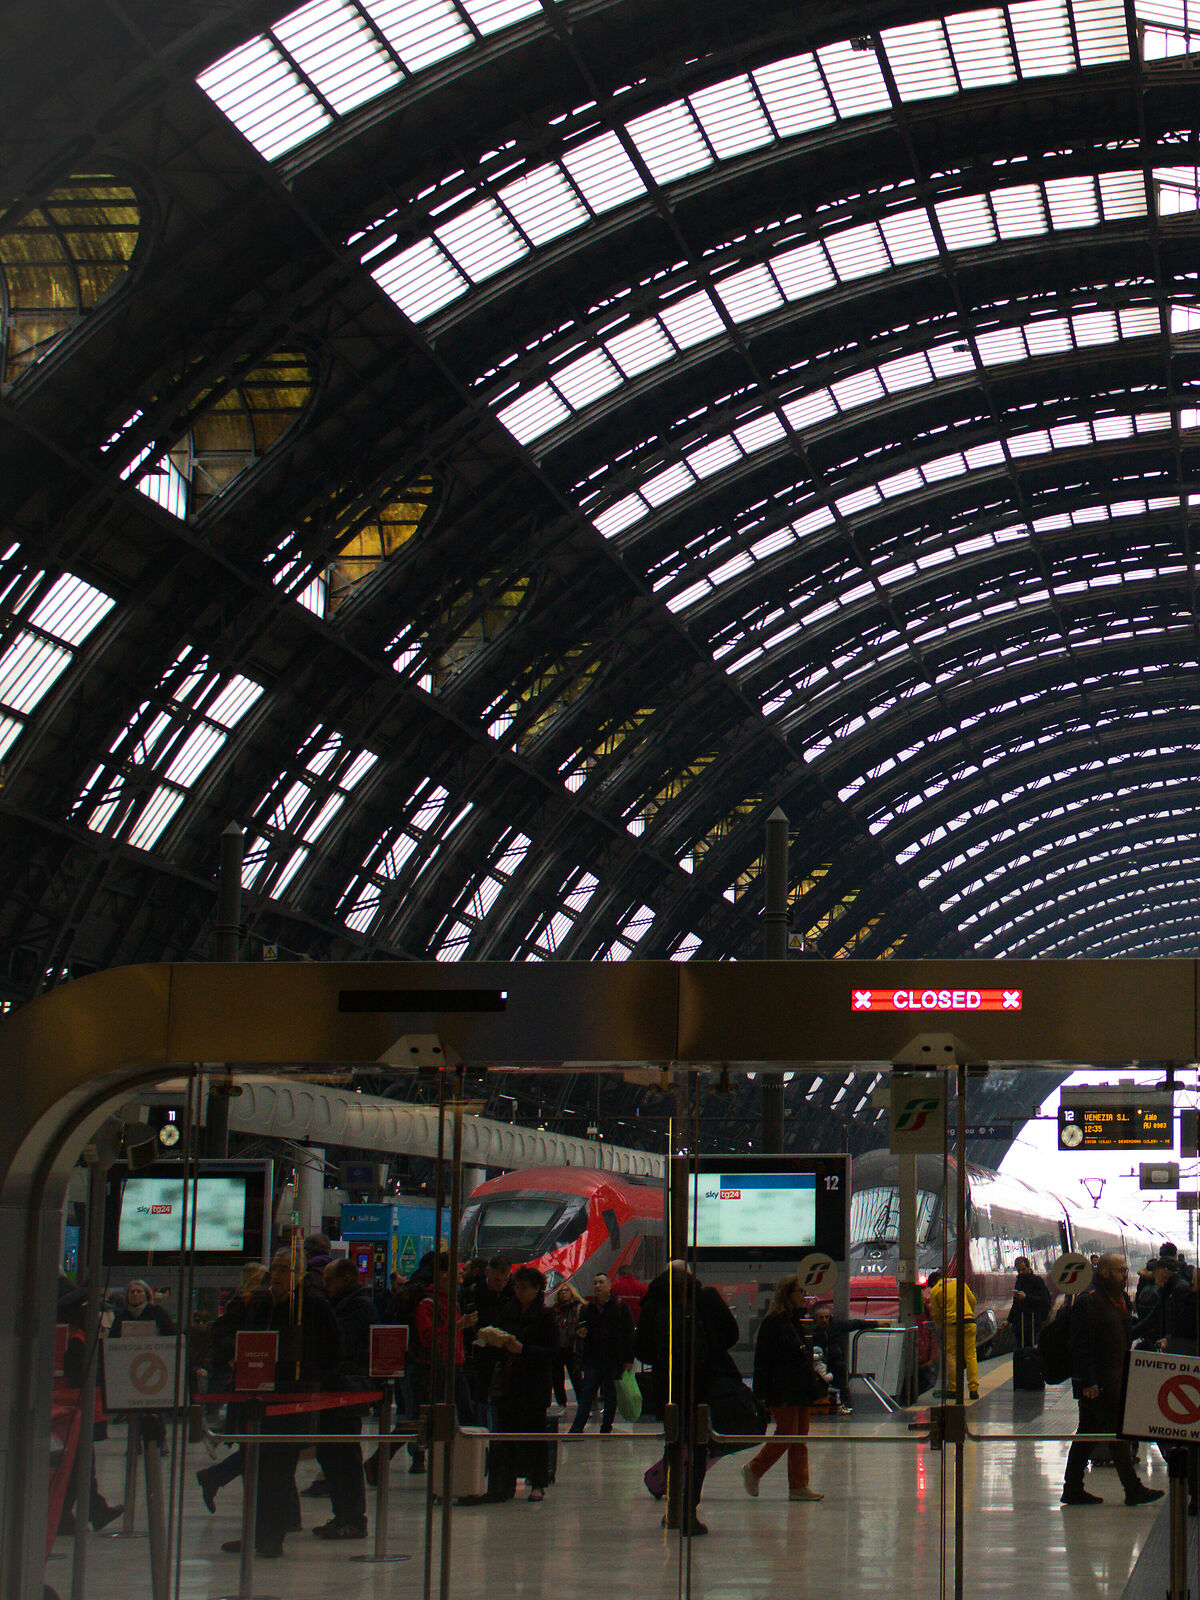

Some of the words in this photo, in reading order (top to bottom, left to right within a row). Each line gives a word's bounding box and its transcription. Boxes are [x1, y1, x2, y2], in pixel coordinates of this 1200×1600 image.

[893, 990, 982, 1009] CLOSED
[168, 1111, 176, 1121] 11
[1064, 1110, 1075, 1121] 12
[1084, 1113, 1113, 1121] VENEZIA
[1116, 1113, 1130, 1121] S.L.
[1084, 1125, 1103, 1133] 12:35
[824, 1175, 840, 1191] 12
[705, 1190, 719, 1199] sky
[721, 1190, 740, 1199] tg24
[136, 1205, 150, 1214] sky
[1134, 1358, 1177, 1371] DIVIETO
[1179, 1363, 1190, 1373] DI
[1148, 1425, 1187, 1438] WRONG
